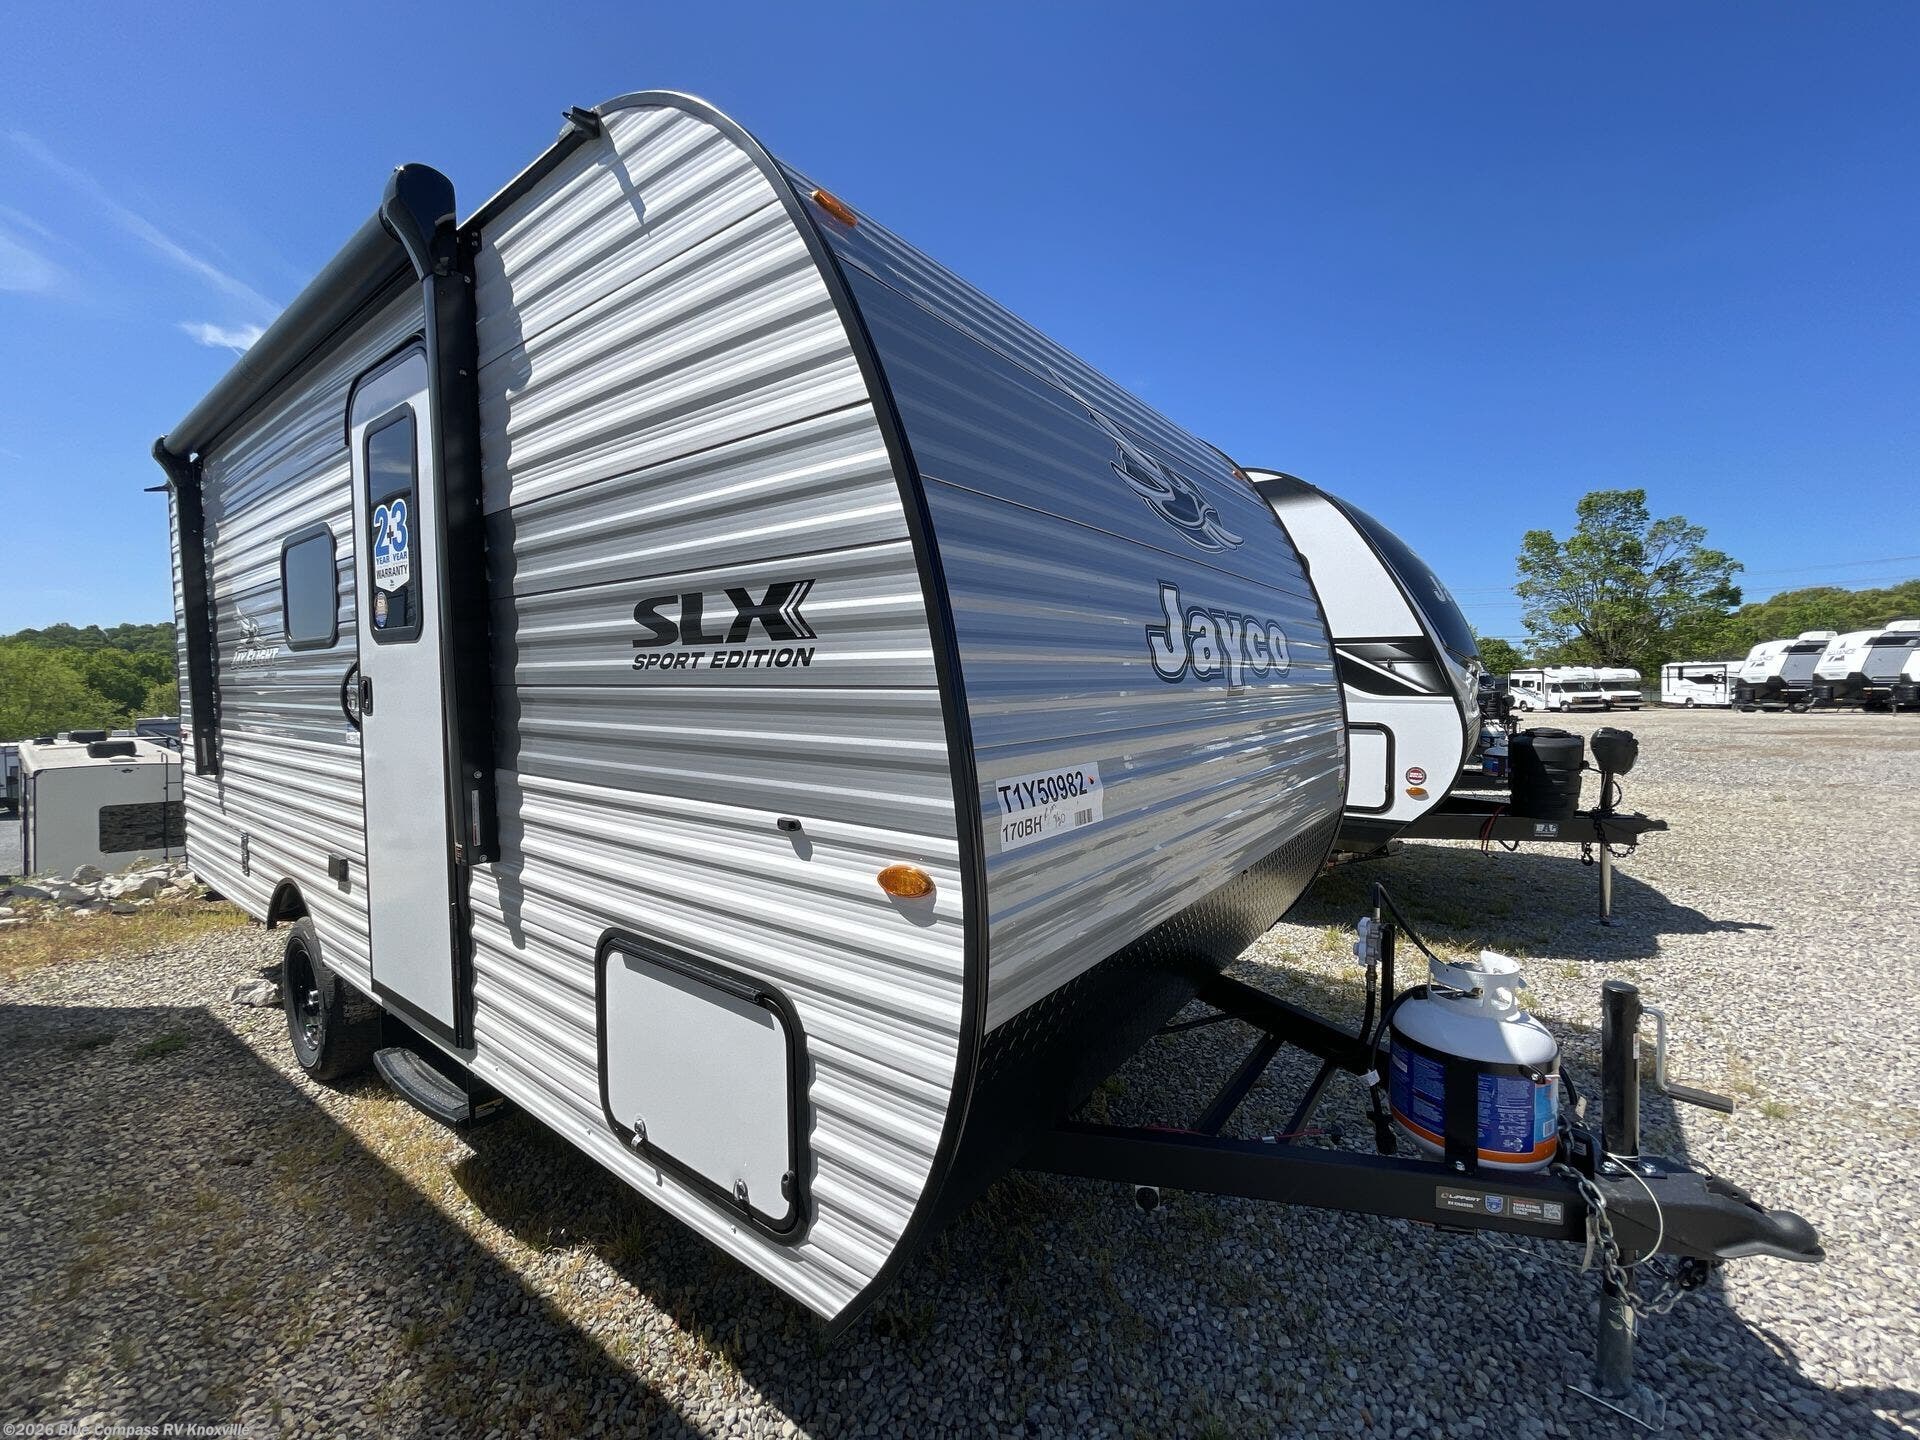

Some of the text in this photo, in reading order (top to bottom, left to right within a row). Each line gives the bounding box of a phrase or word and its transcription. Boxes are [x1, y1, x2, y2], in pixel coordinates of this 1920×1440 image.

[376, 551, 407, 565] YEAR YEAR
[376, 564, 408, 580] WARRANTY
[632, 579, 818, 648] SLX
[1145, 578, 1292, 697] Jayco
[632, 647, 815, 671] SPORT EDITION
[998, 771, 1088, 813] T1Y50982
[1003, 815, 1042, 842] 170BH
